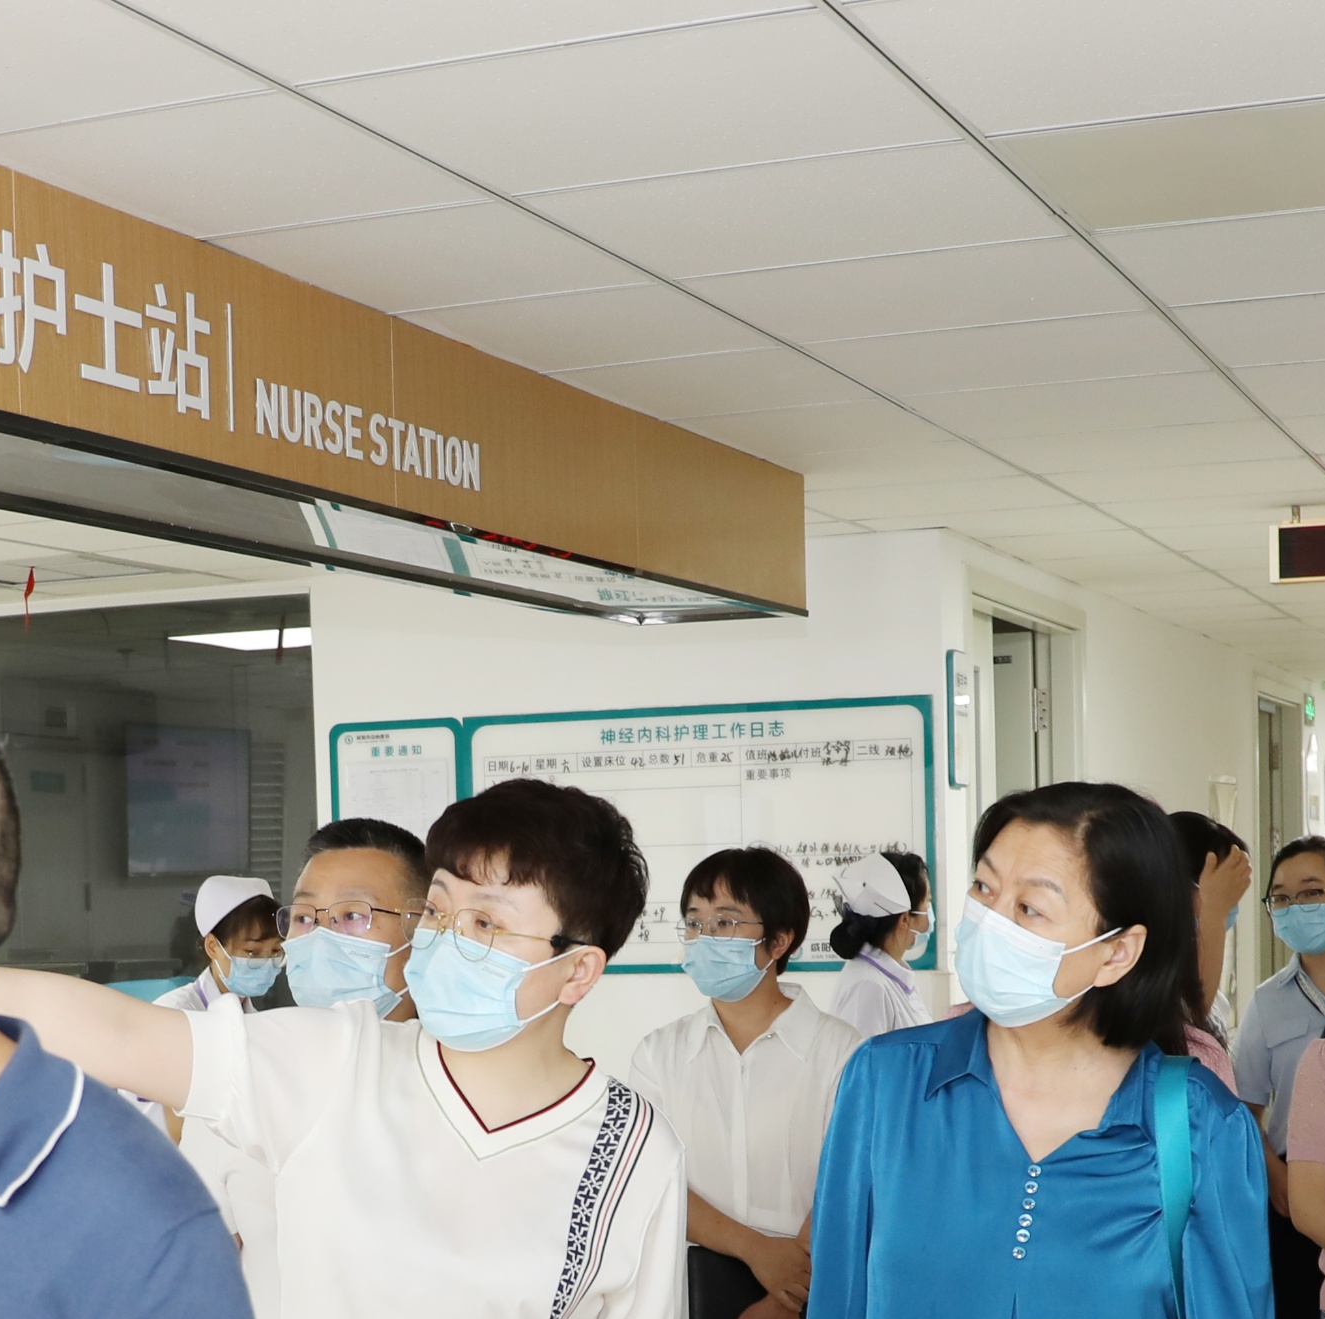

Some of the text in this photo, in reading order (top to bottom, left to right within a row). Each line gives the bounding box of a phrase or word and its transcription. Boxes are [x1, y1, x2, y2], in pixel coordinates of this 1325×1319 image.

[255, 377, 481, 492] NURSE STATION
[600, 720, 786, 745] 神经内科护理工作日志
[371, 744, 422, 758] 重要通知
[488, 760, 509, 772] 日期
[535, 758, 557, 771] 星期
[581, 755, 626, 768] 设置床位
[649, 753, 670, 765] 总数
[696, 752, 719, 764] 危重
[745, 749, 767, 761] 值班
[857, 744, 879, 756] 二线
[745, 768, 791, 781] 重要事项
